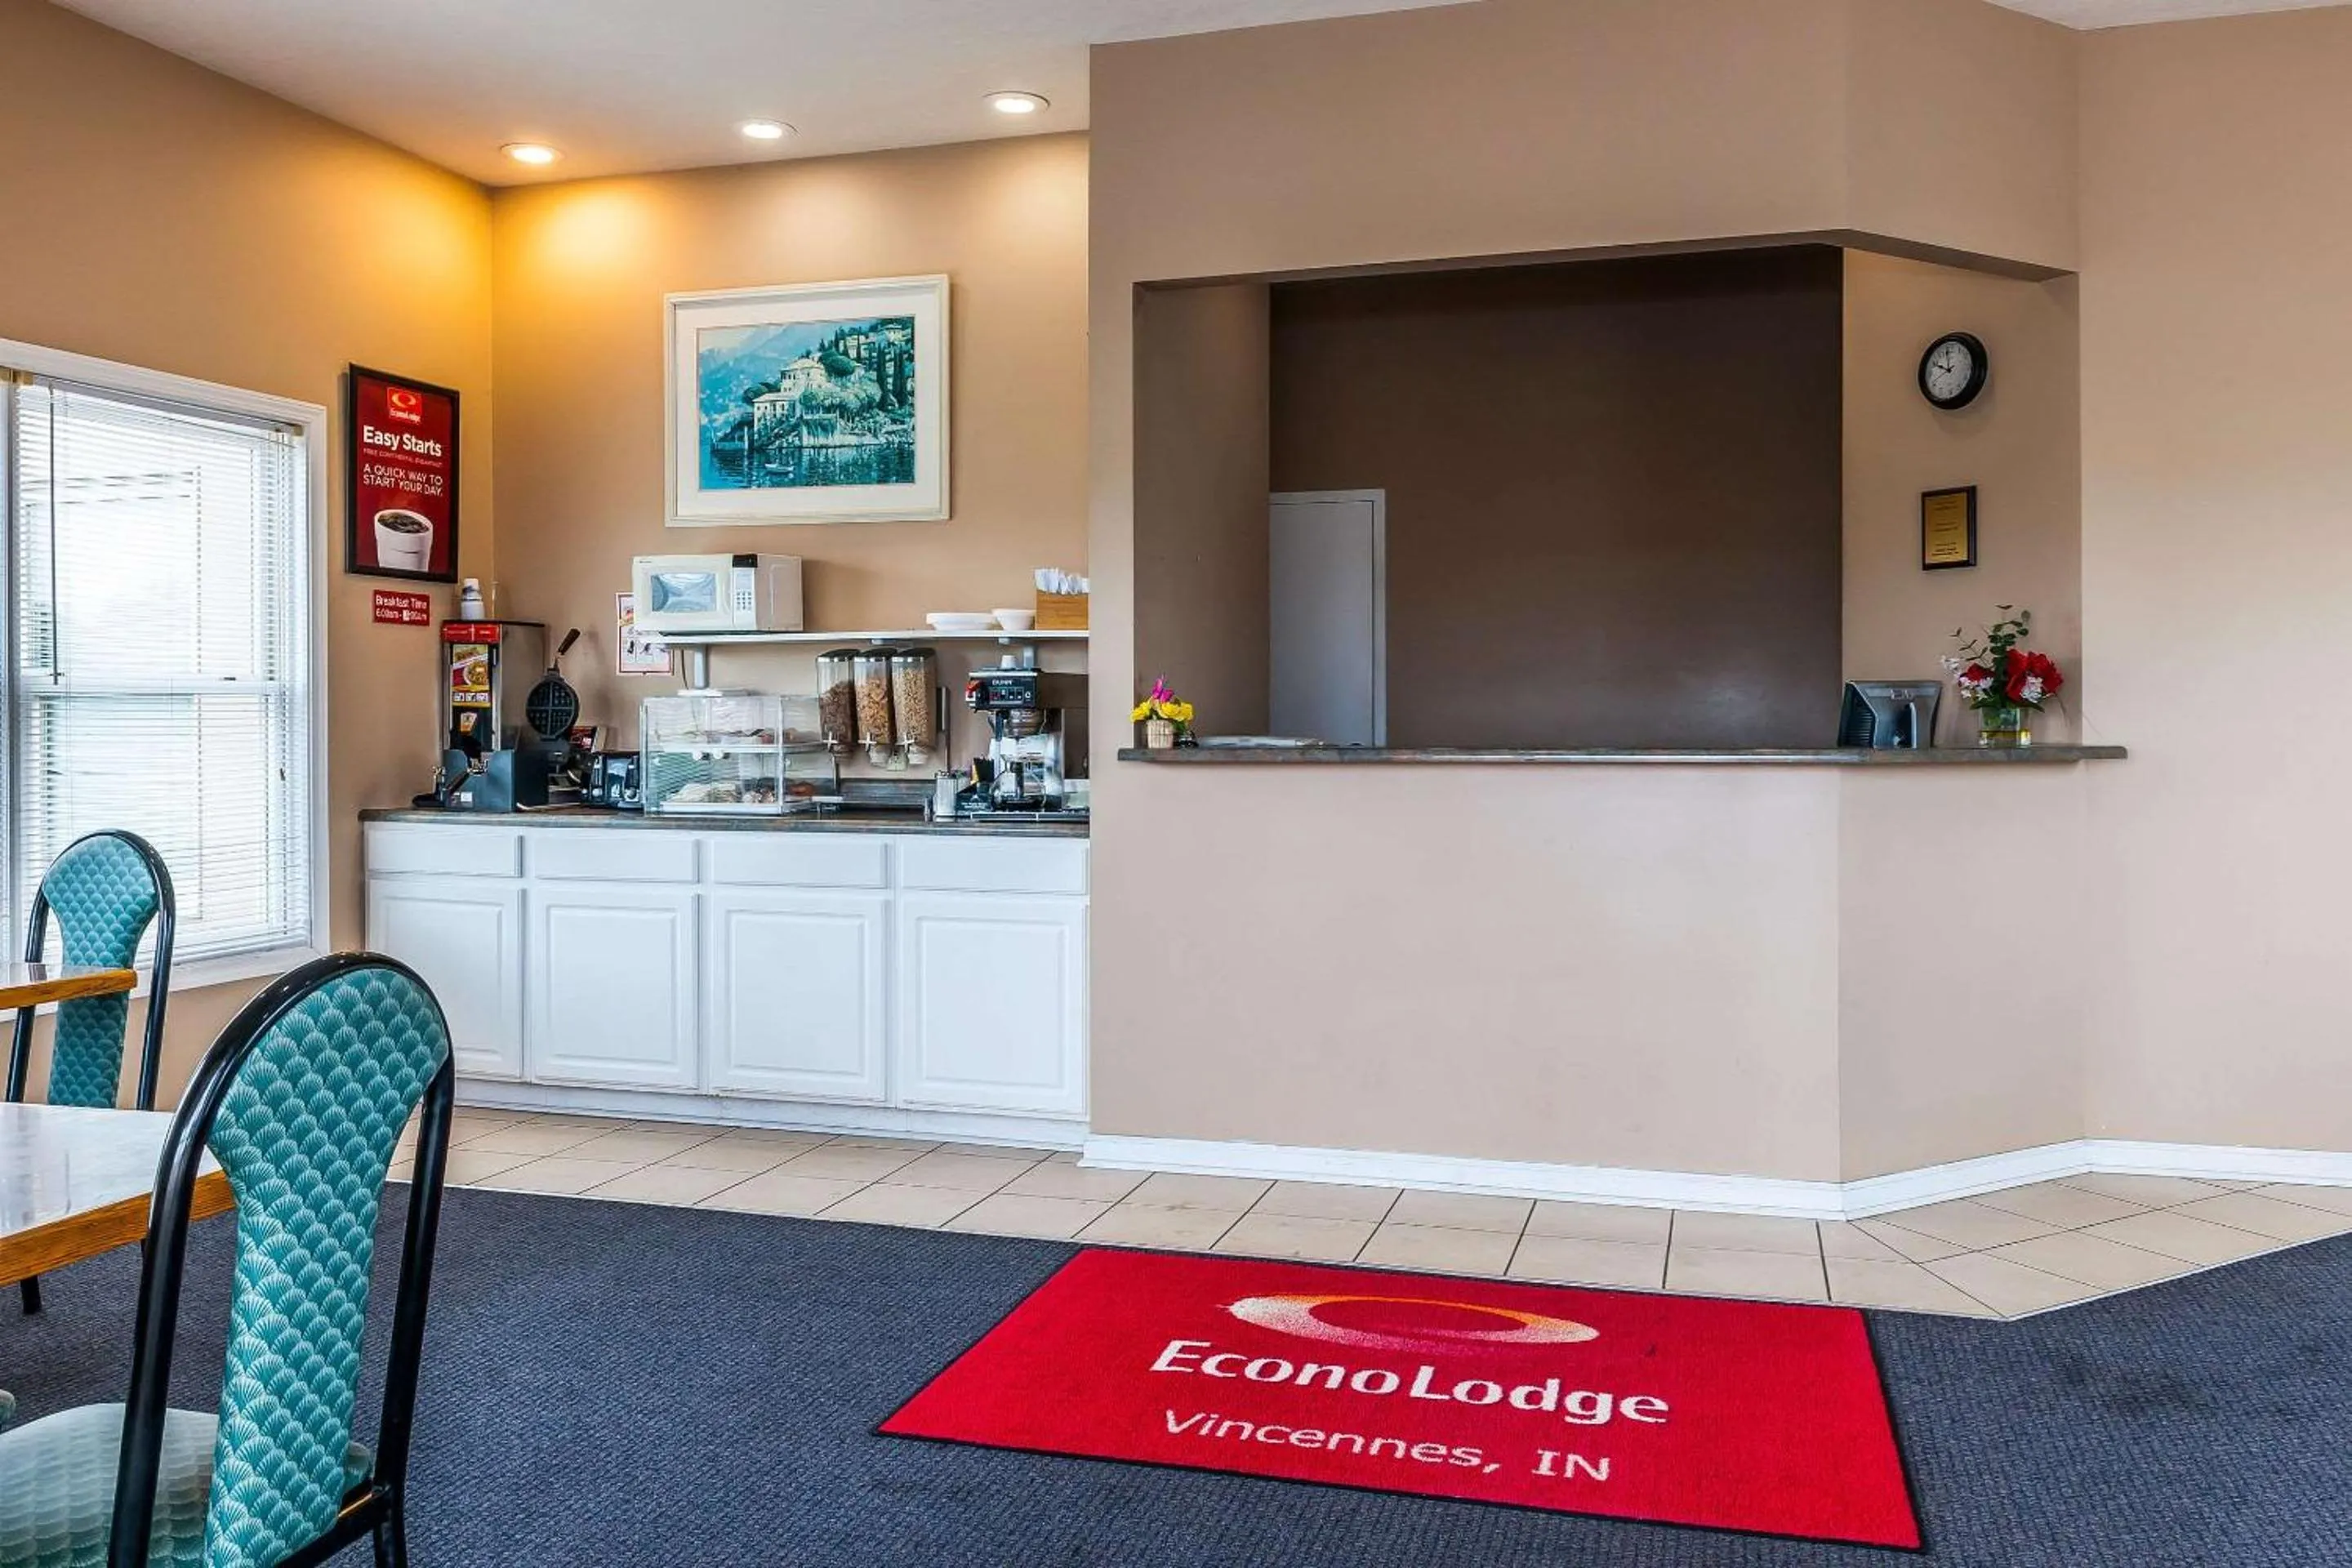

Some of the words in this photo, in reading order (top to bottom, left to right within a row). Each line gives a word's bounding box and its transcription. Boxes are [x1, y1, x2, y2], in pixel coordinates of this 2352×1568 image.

[363, 425, 400, 451] Easy
[403, 433, 442, 457] Starts
[363, 463, 371, 473] A
[374, 465, 406, 479] QUICK
[408, 470, 427, 483] WAY
[430, 474, 443, 486] TO
[363, 474, 395, 488] START
[398, 479, 423, 493] YOUR
[1150, 1339, 1669, 1426] EconoLodge
[1165, 1409, 1502, 1474] Vincennes,
[1532, 1448, 1612, 1482] IN
